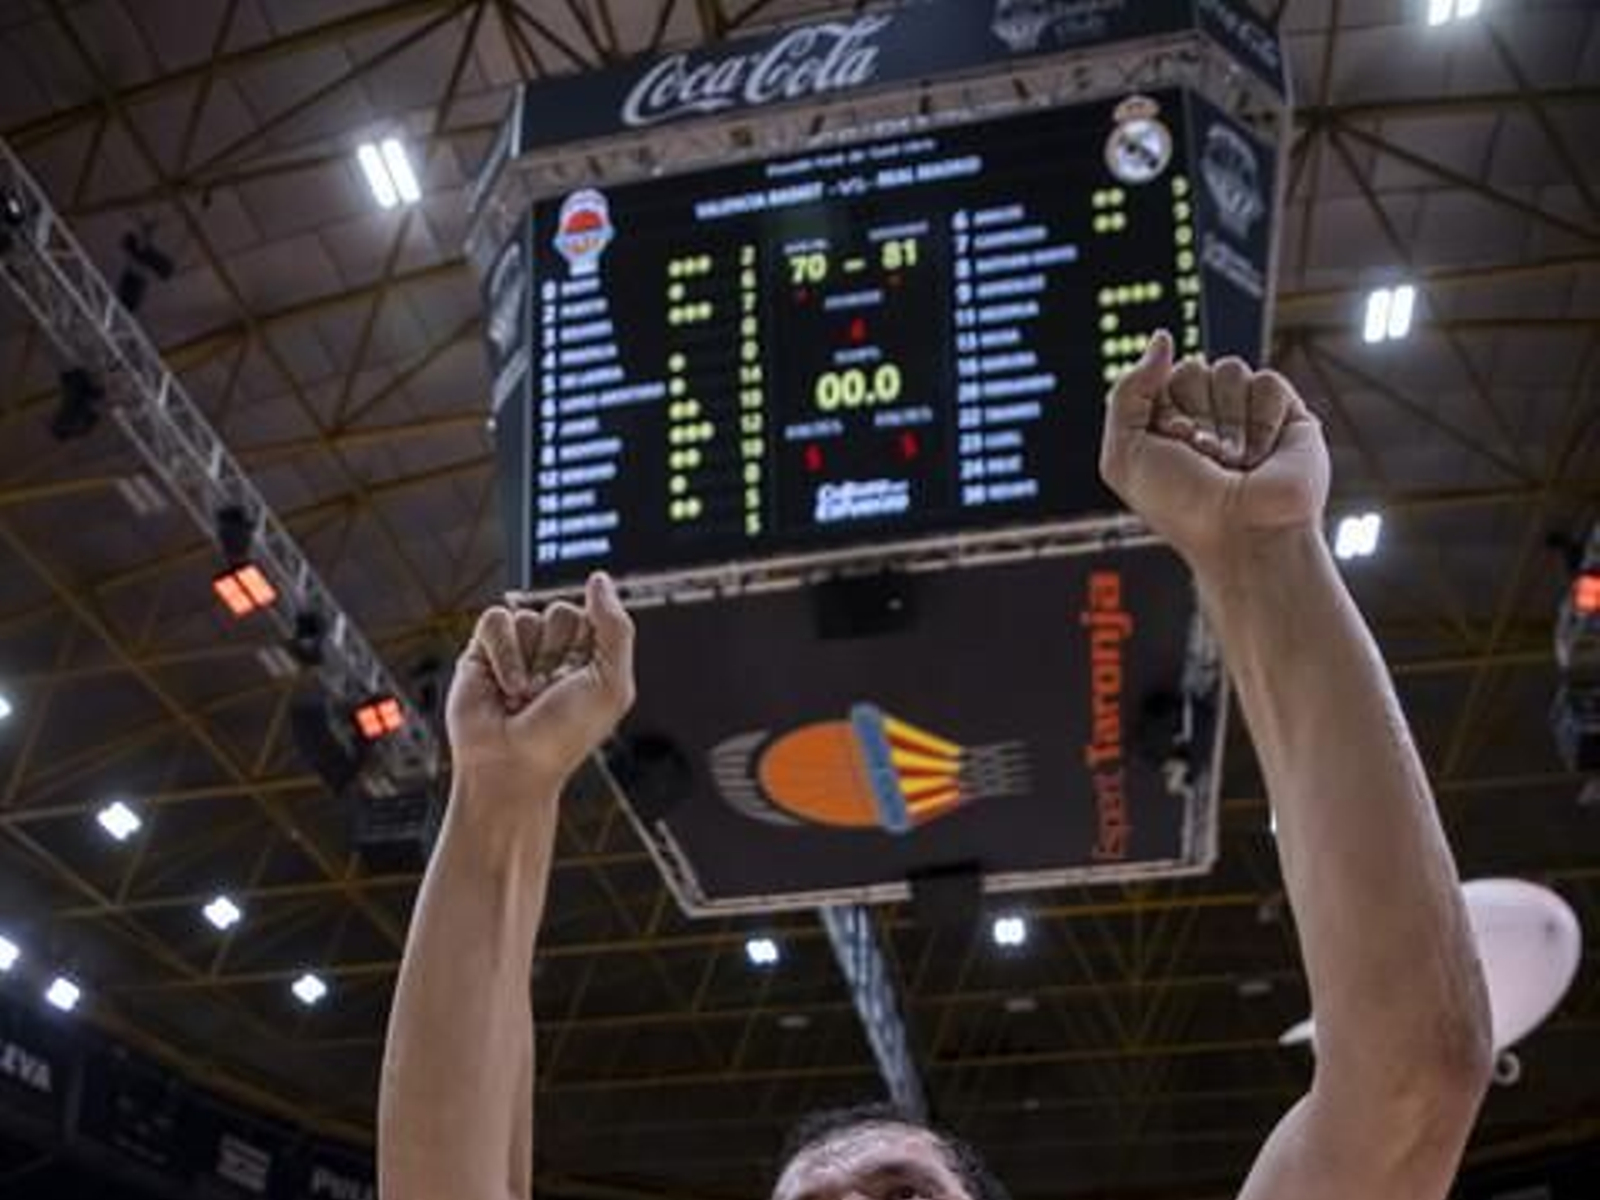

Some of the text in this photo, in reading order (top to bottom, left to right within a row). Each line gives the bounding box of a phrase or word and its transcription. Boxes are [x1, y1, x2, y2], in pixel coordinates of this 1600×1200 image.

[789, 252, 828, 284] 70
[880, 239, 917, 270] 81
[815, 362, 902, 411] 00.0
